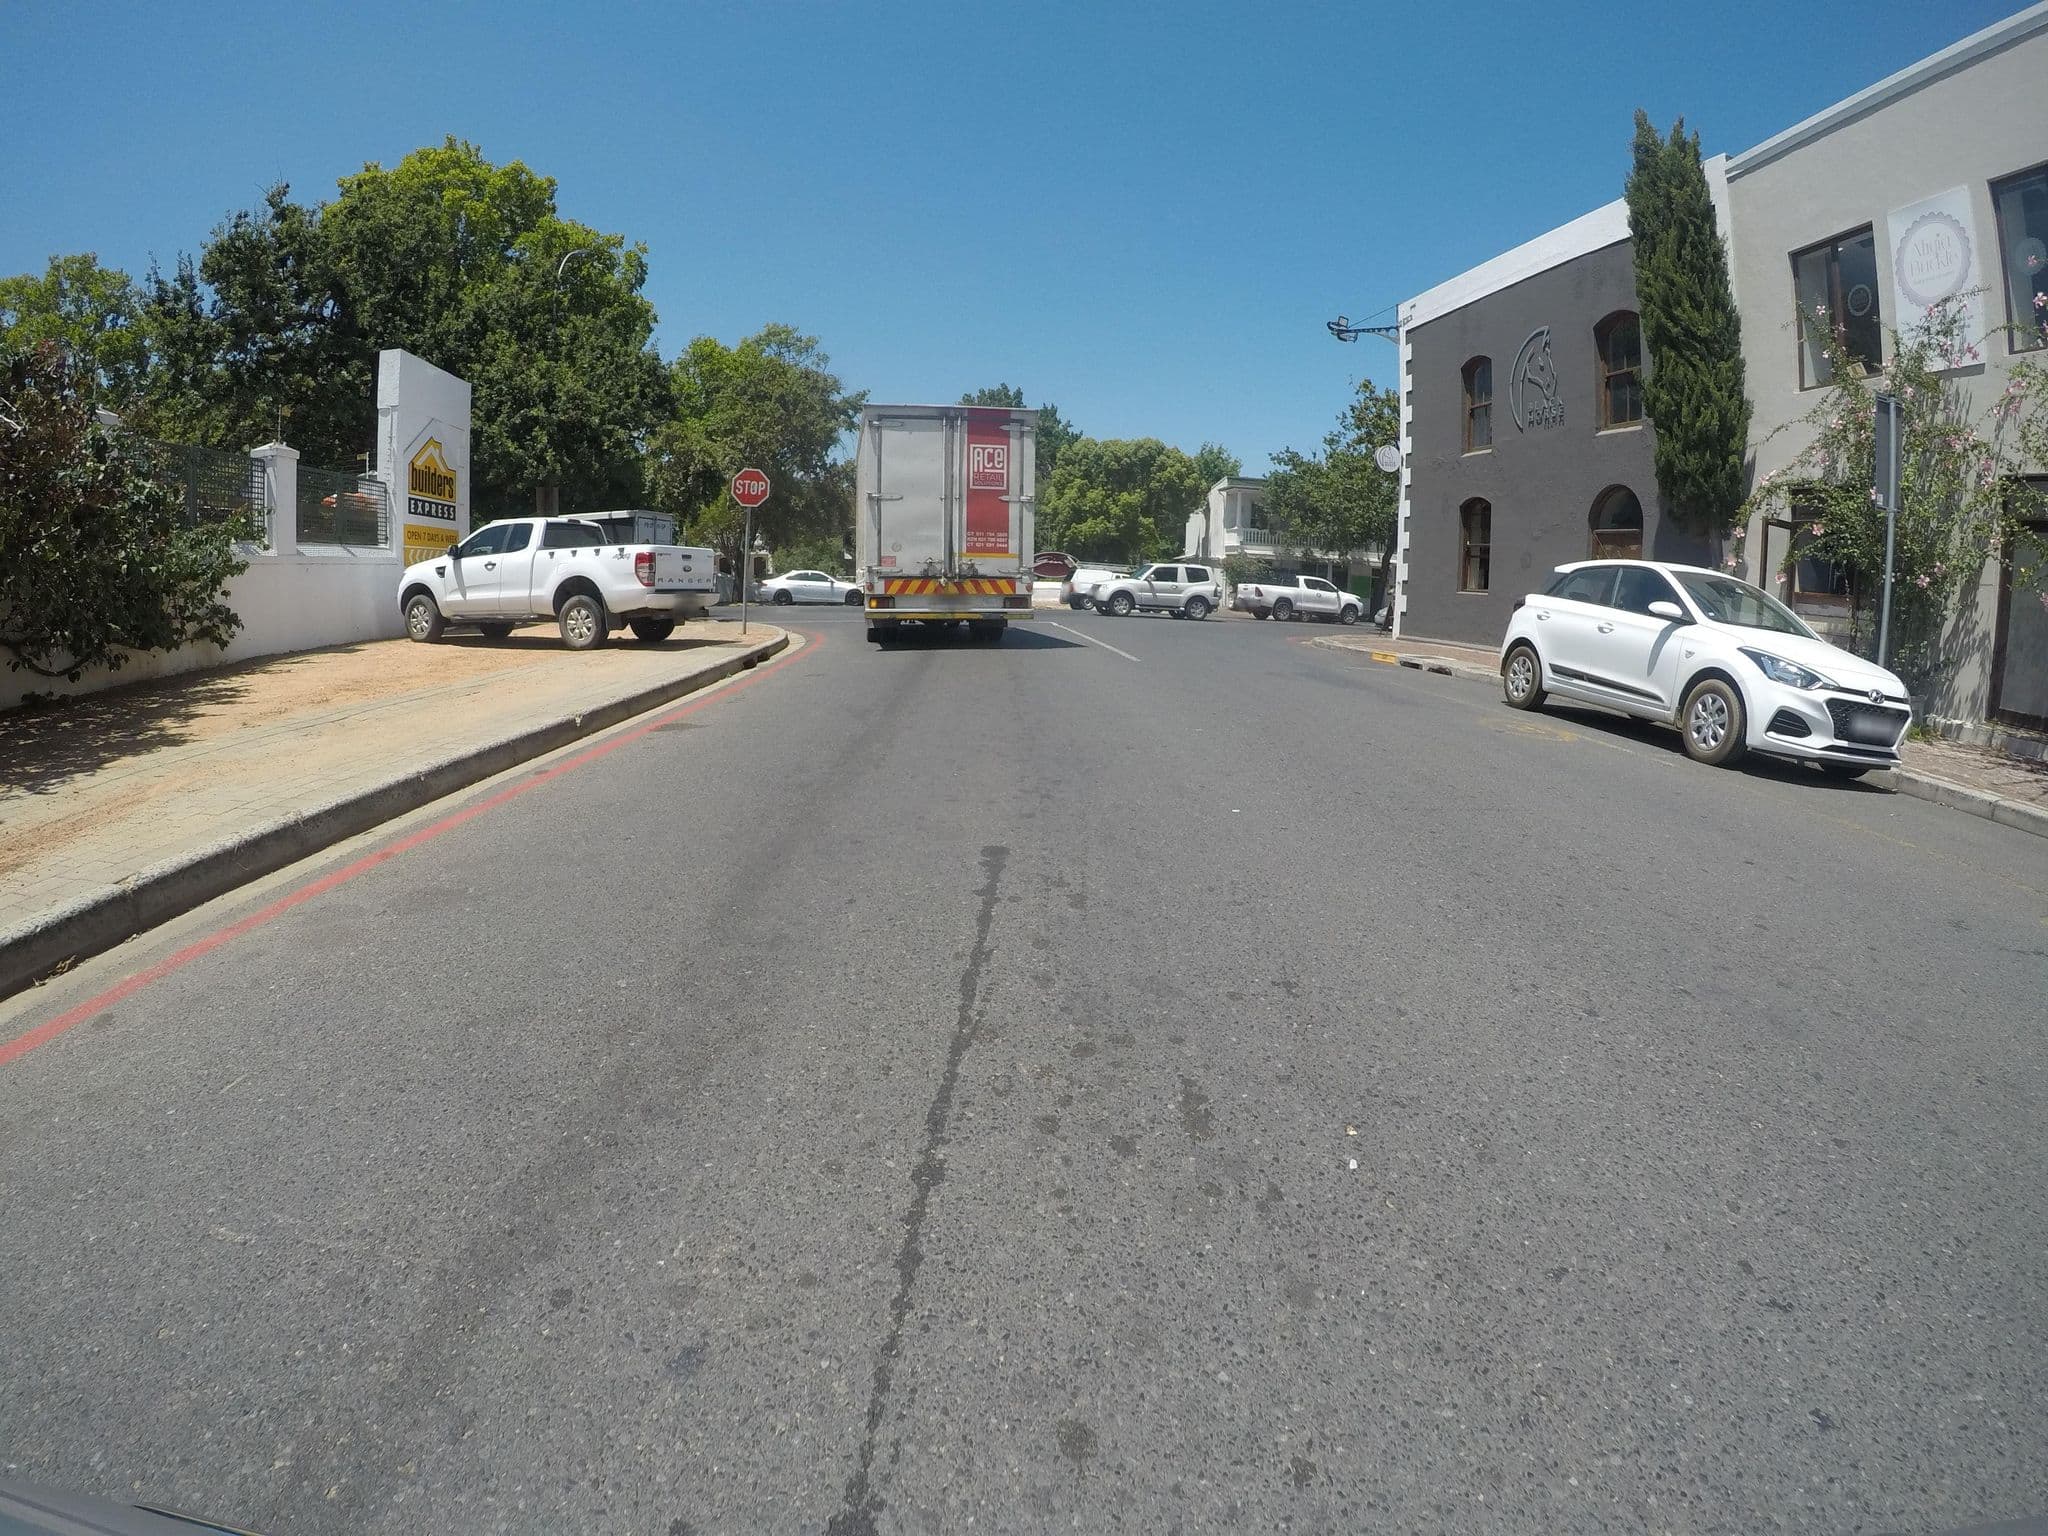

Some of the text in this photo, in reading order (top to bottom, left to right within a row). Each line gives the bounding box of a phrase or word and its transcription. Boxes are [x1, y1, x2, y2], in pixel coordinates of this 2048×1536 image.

[411, 462, 453, 498] builders
[973, 472, 1004, 481] RETAIL
[735, 479, 766, 496] STOP
[411, 499, 454, 519] EXPRESS
[406, 530, 421, 541] OPEN
[427, 532, 440, 543] DAYS
[445, 534, 458, 544] WEEK
